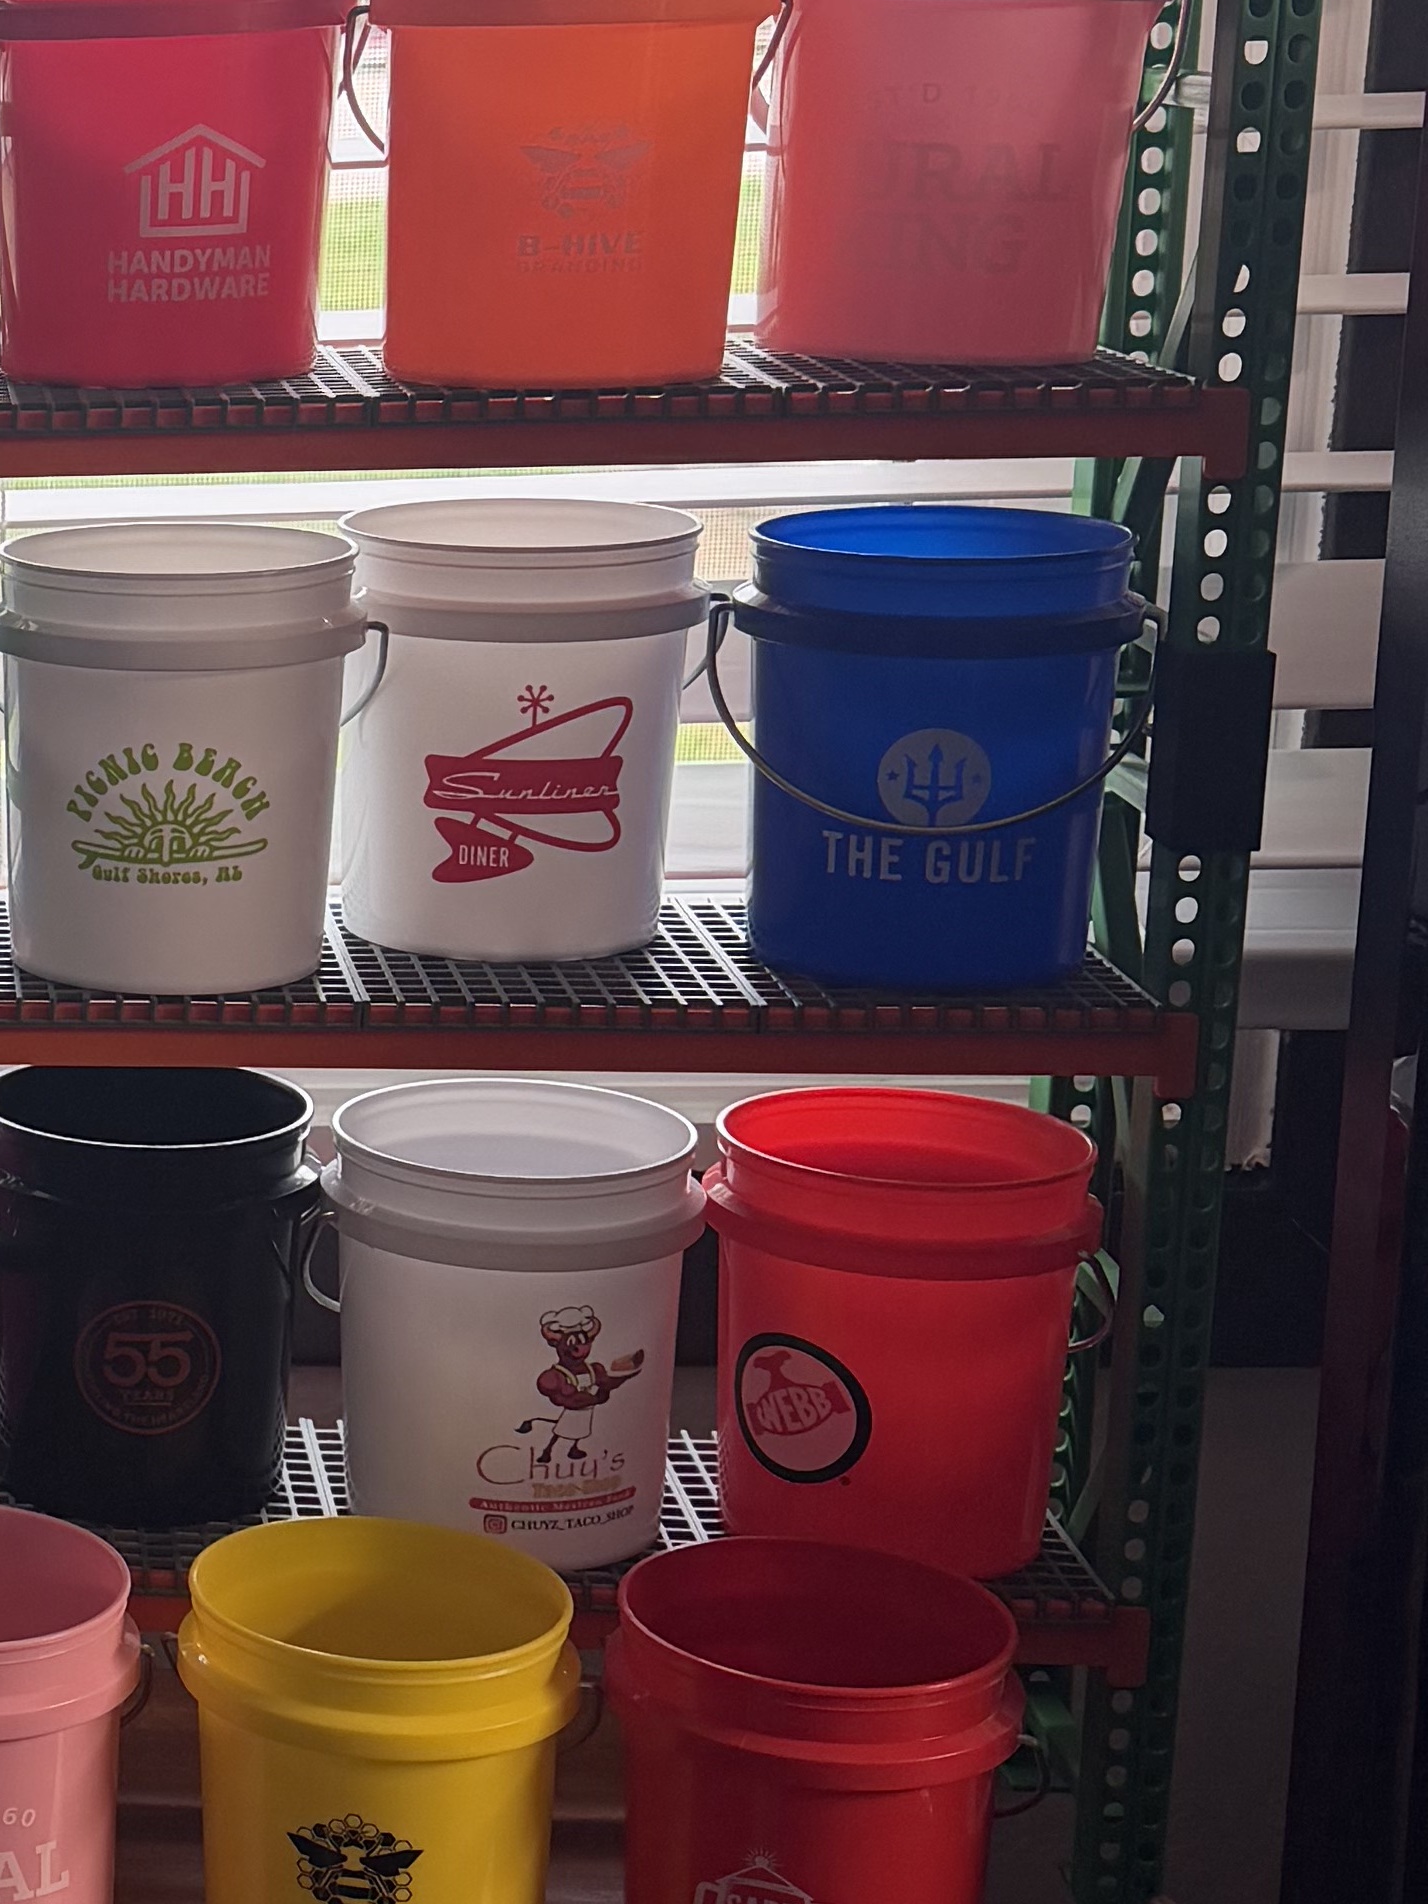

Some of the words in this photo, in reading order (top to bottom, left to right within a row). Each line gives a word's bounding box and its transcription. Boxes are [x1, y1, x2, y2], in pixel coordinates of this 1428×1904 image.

[107, 243, 272, 277] HANDYMAN
[107, 273, 270, 305] HARDWARE
[66, 744, 159, 823] PICNIC
[173, 742, 270, 823] BEACH
[432, 772, 620, 801] Sunliner
[458, 844, 510, 868] DINER
[822, 830, 904, 882] THE
[924, 835, 1037, 884] GULF
[91, 864, 131, 883] Gulf
[102, 1331, 195, 1387] 55
[756, 1386, 830, 1434] WEBB
